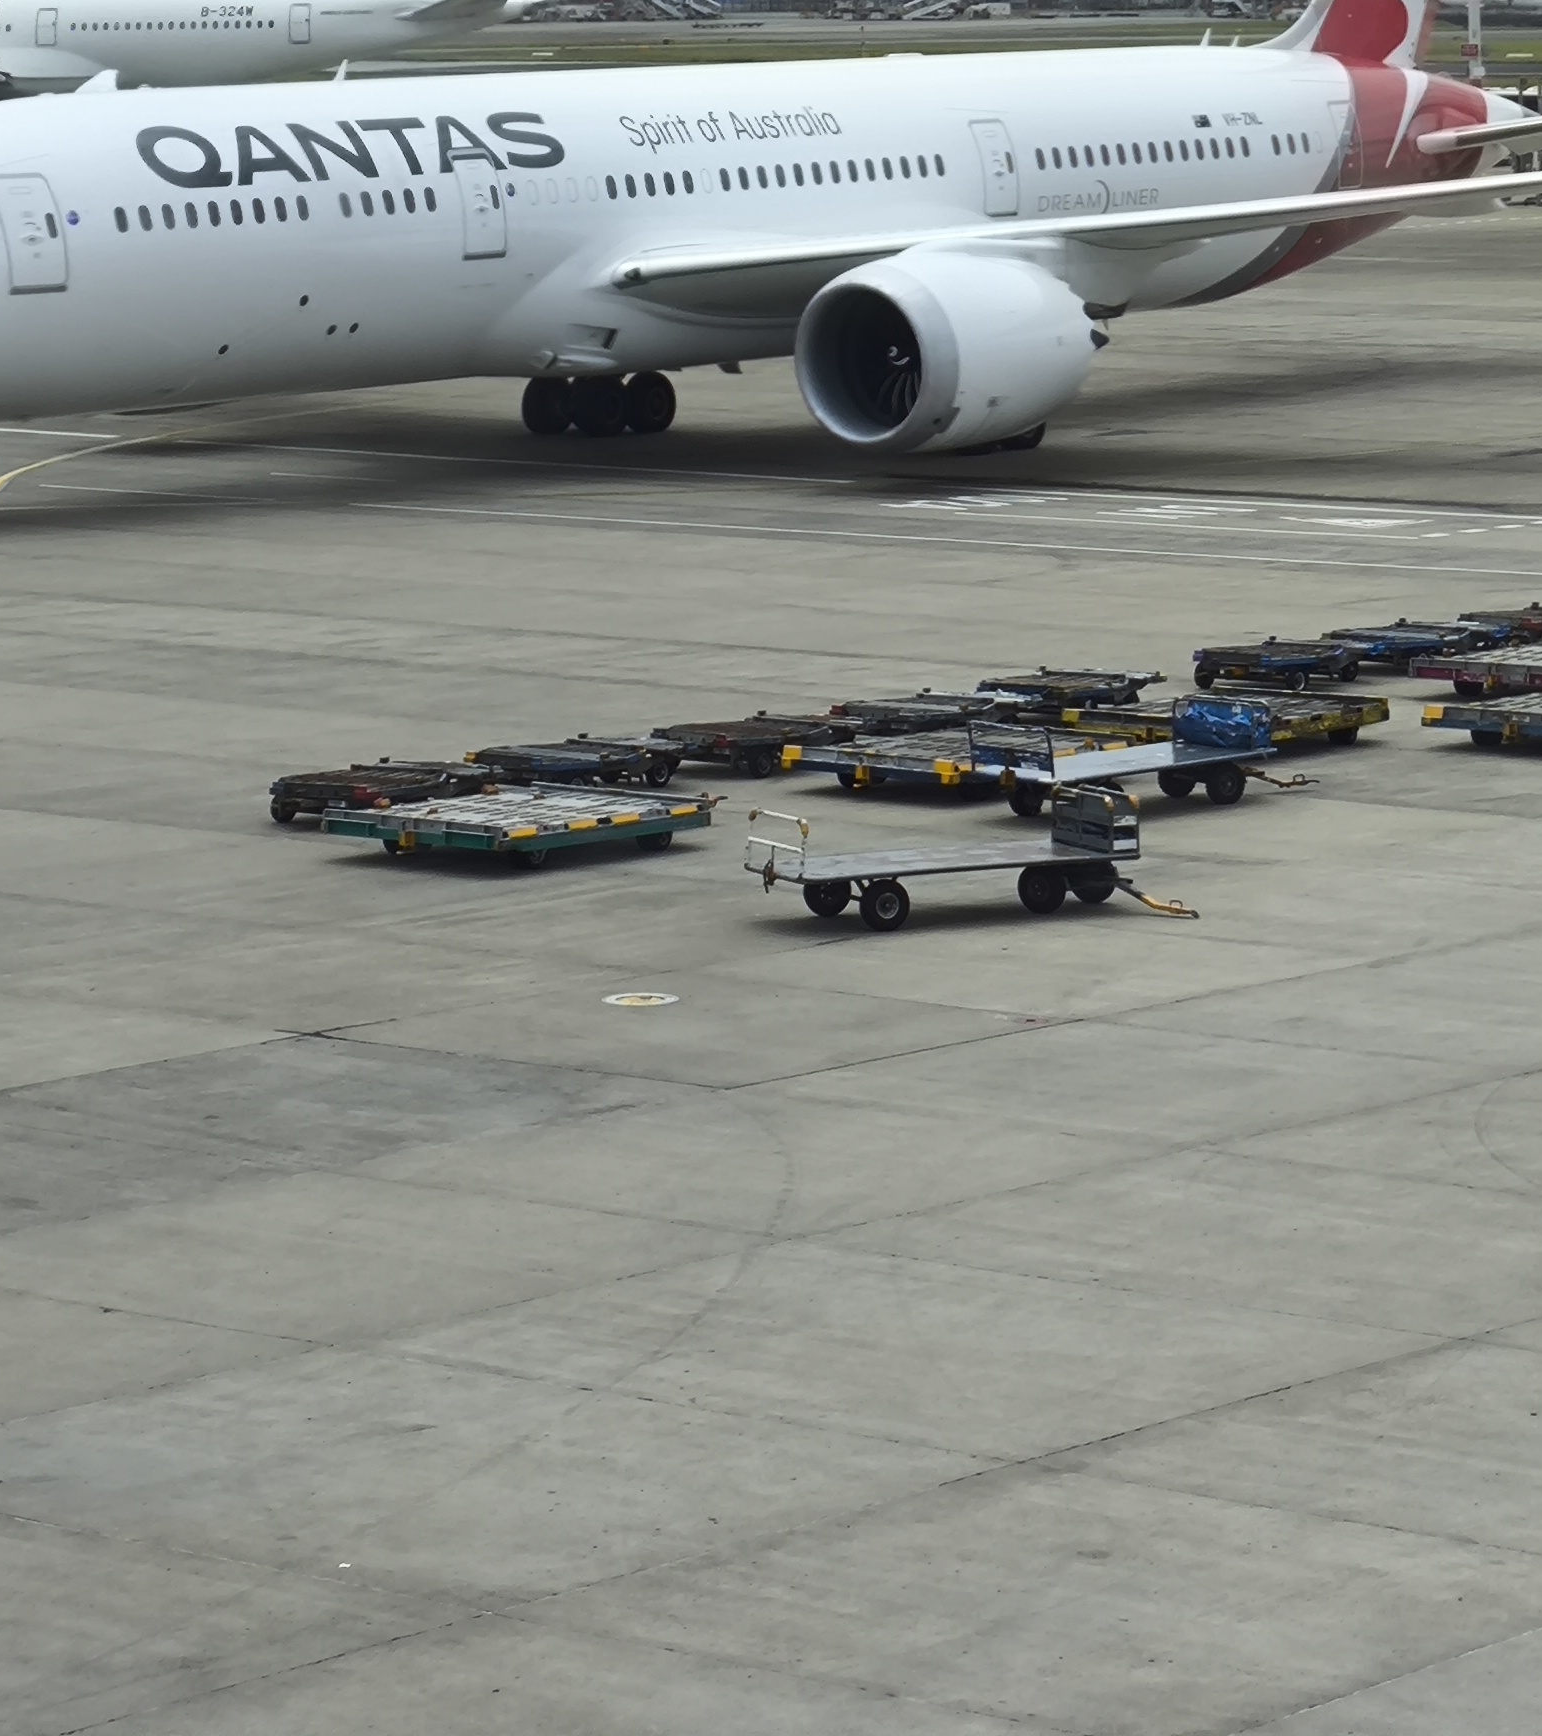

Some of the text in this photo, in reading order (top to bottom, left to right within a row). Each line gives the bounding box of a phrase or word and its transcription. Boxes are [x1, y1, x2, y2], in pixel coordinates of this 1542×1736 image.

[201, 5, 254, 17] B-324W
[135, 105, 843, 189] QANTAS Spirit of Australia
